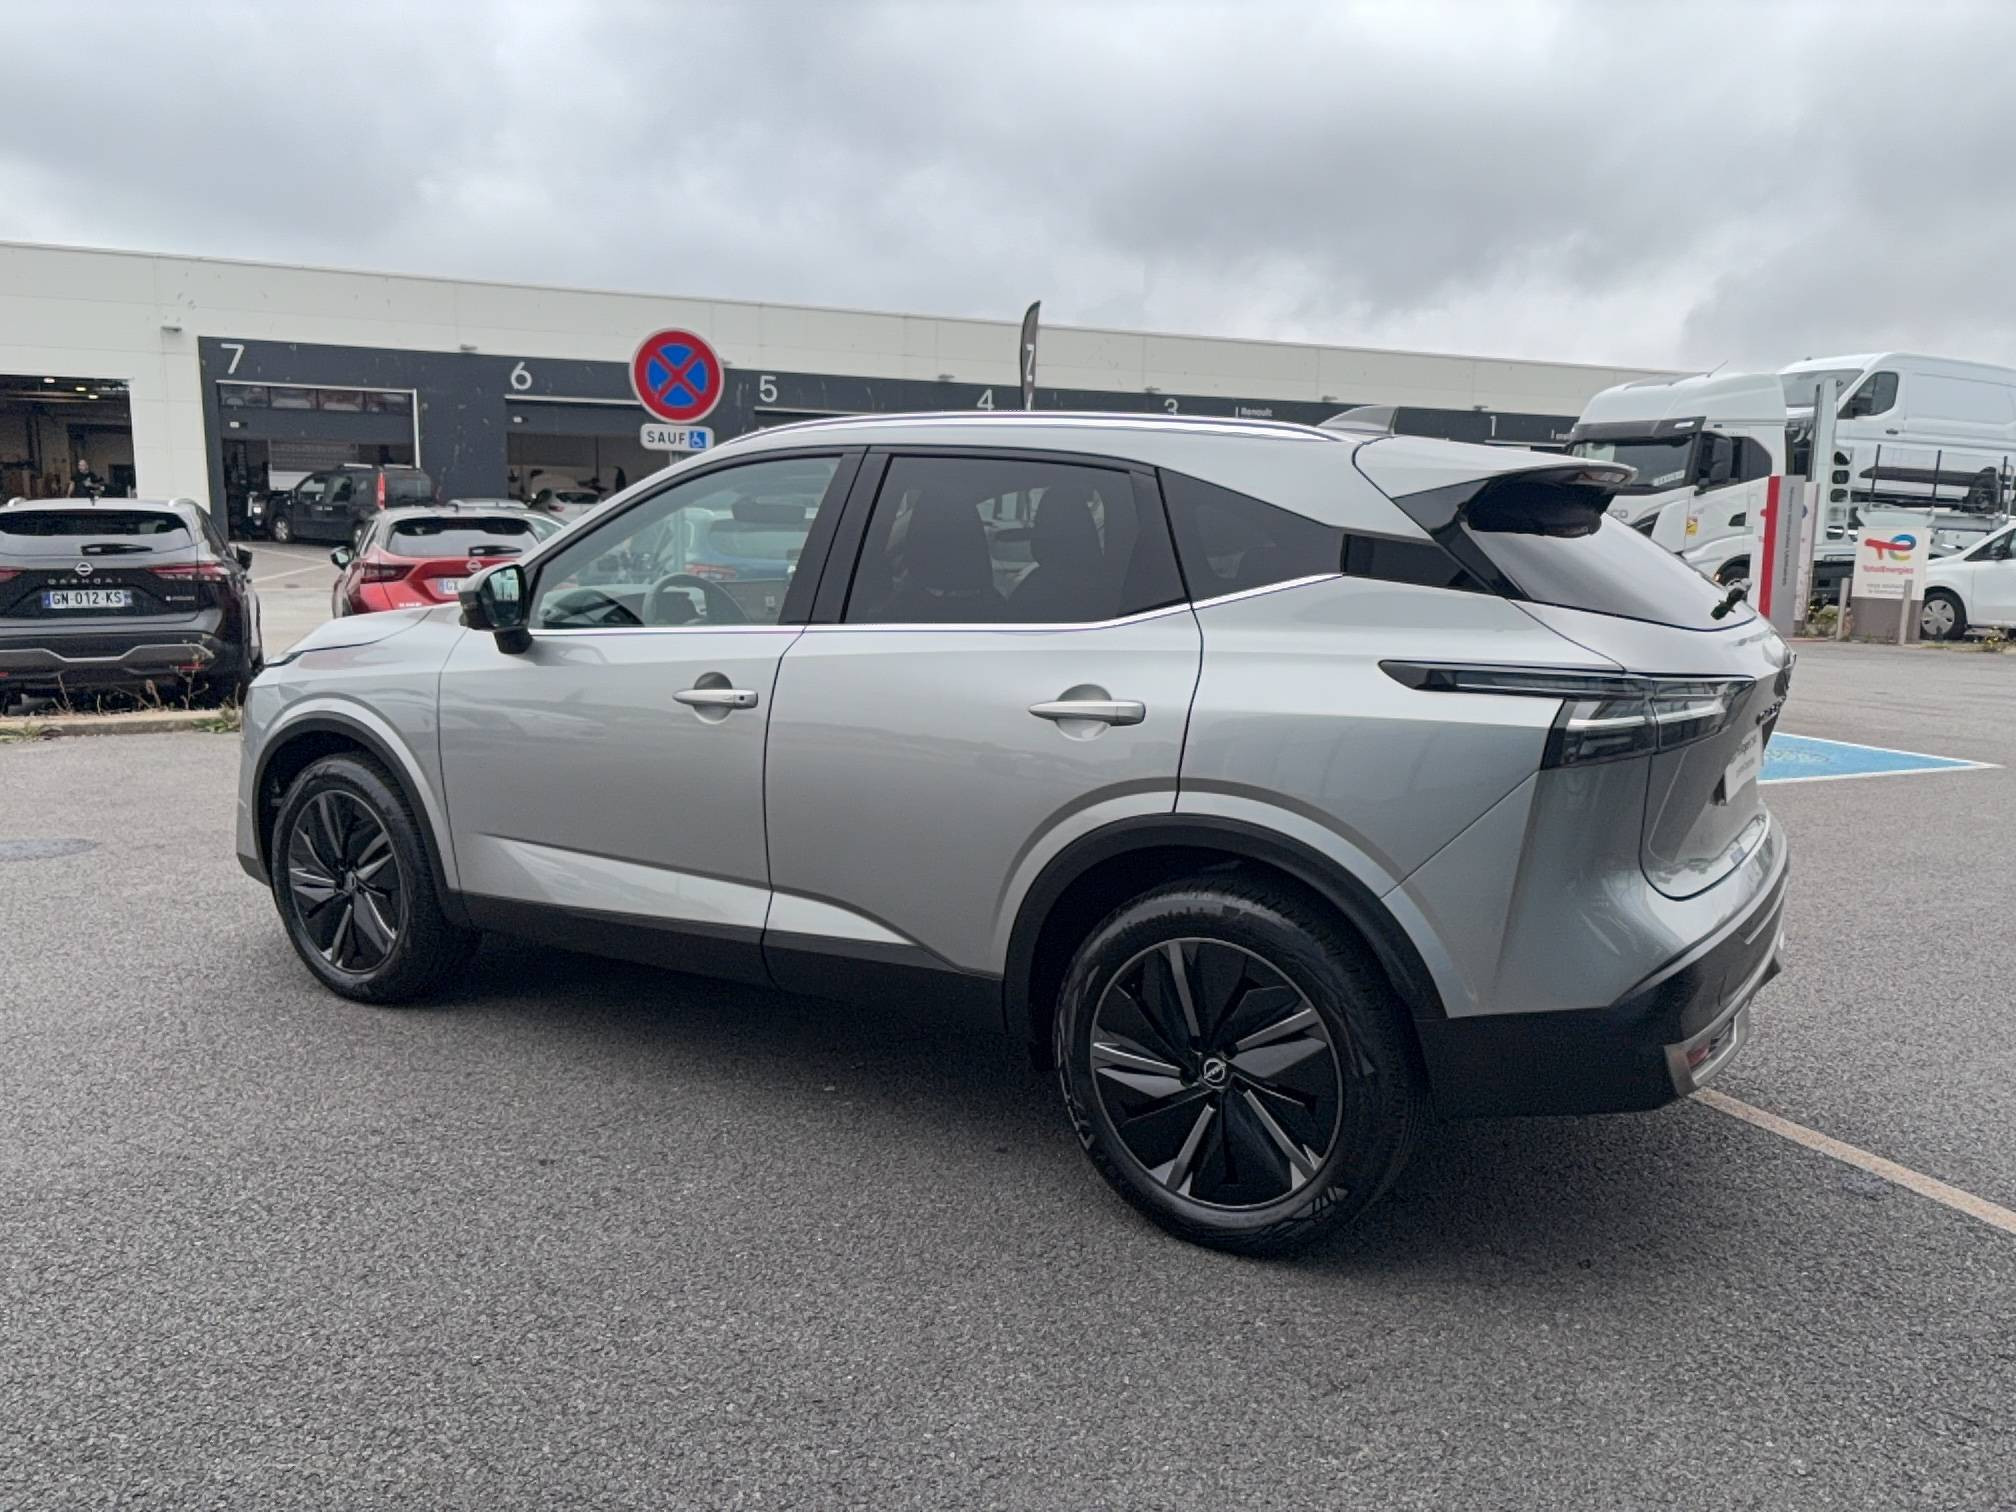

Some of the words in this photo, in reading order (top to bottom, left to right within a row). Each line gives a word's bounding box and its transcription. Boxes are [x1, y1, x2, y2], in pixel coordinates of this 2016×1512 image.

[221, 343, 245, 374] 7
[511, 361, 532, 390] 6
[760, 375, 778, 402] 5
[977, 388, 995, 411] 4
[646, 430, 686, 445] SAUF
[1489, 415, 1497, 437] 1
